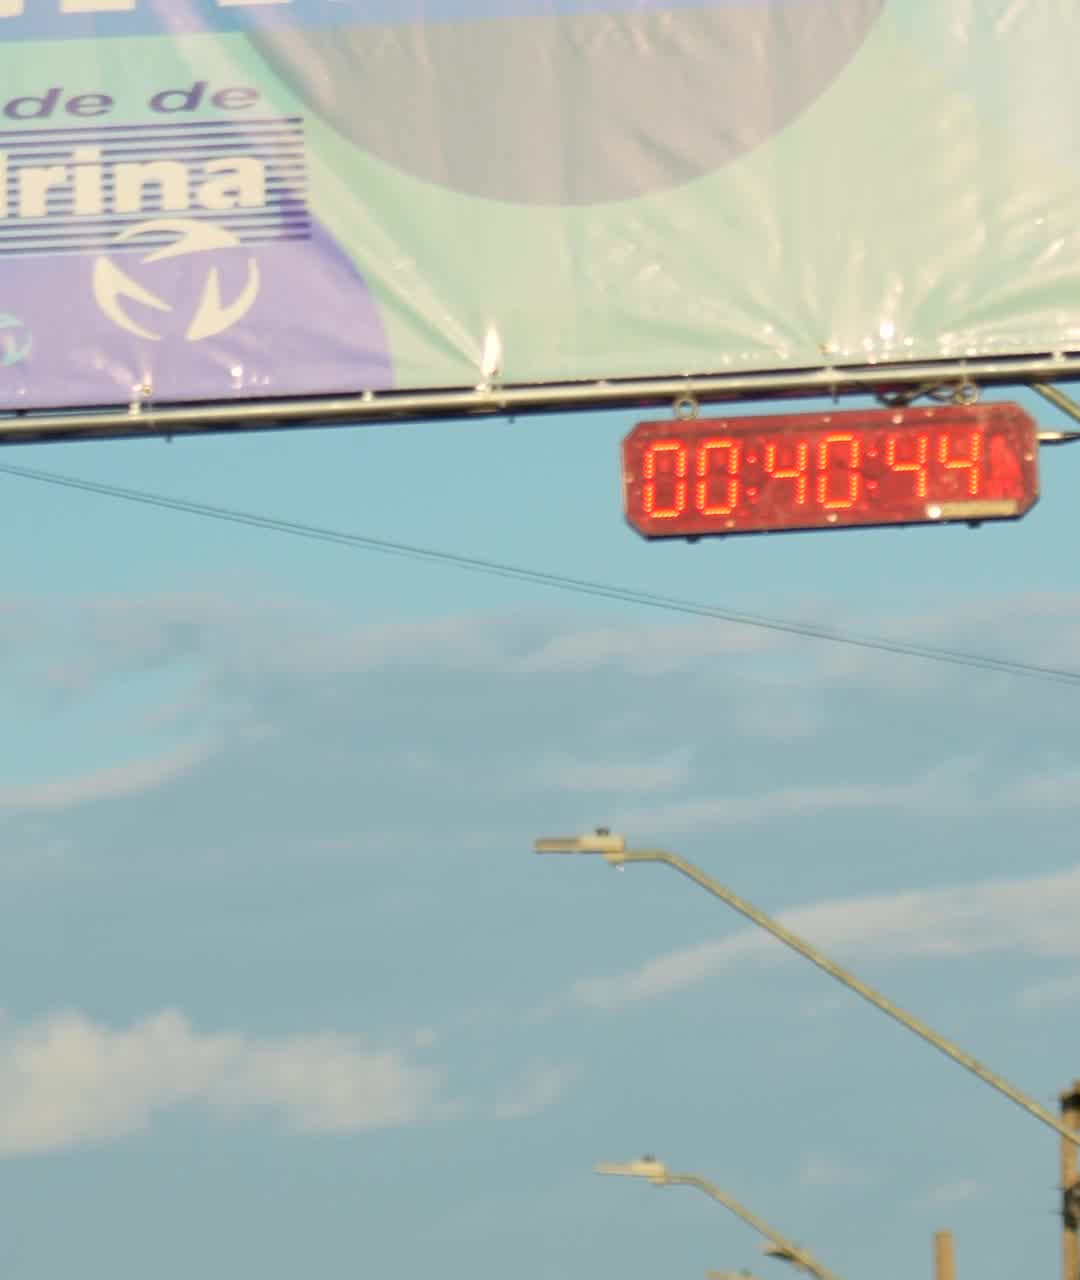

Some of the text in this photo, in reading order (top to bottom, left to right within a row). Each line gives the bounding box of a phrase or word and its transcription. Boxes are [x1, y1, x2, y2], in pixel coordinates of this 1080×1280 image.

[149, 80, 260, 113] de
[0, 145, 266, 219] rina
[642, 431, 982, 519] 00:40:44
